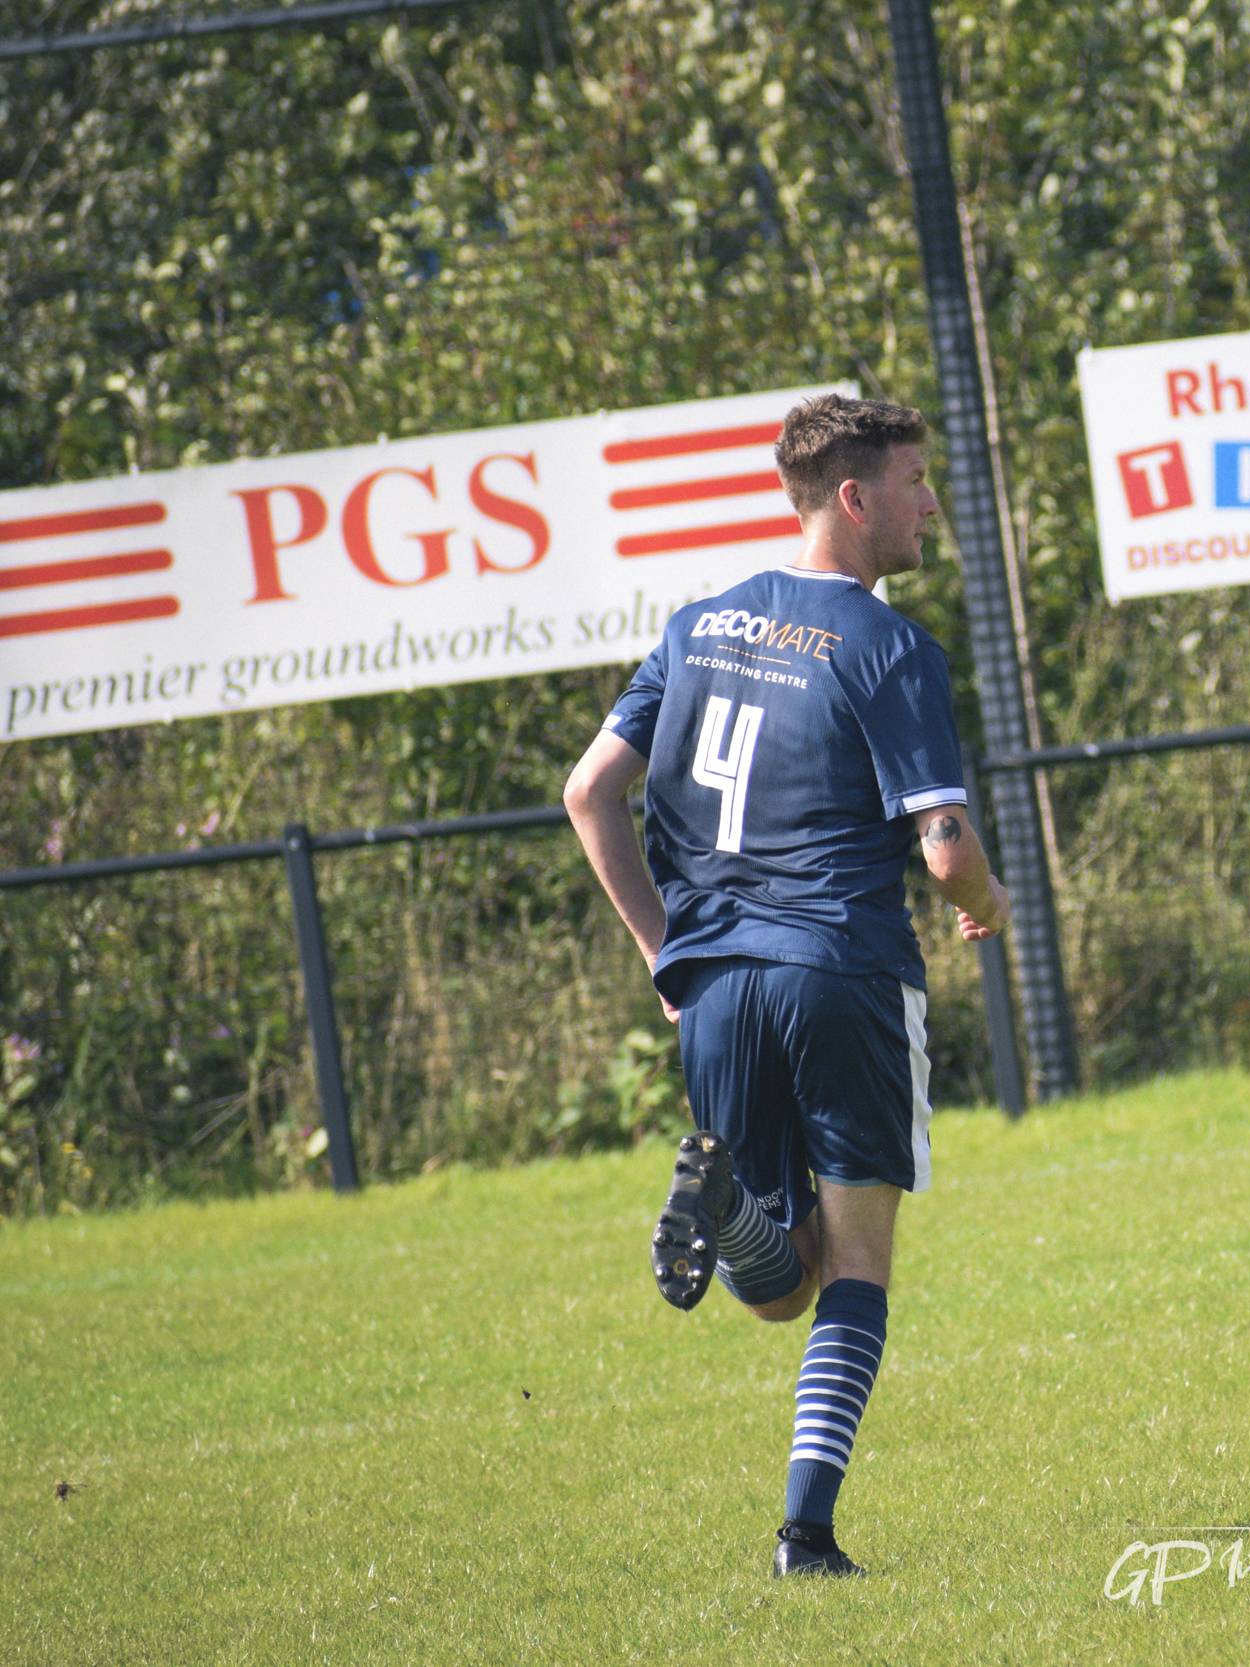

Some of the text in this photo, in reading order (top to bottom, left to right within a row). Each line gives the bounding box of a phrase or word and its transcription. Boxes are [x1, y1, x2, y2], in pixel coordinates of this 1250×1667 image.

[229, 450, 552, 606] PGS
[4, 653, 208, 735] premier
[220, 605, 556, 708] groundworks
[685, 654, 808, 689] DECORATING CENTRE
[691, 609, 843, 662] DECOMATE
[691, 694, 765, 854] 4
